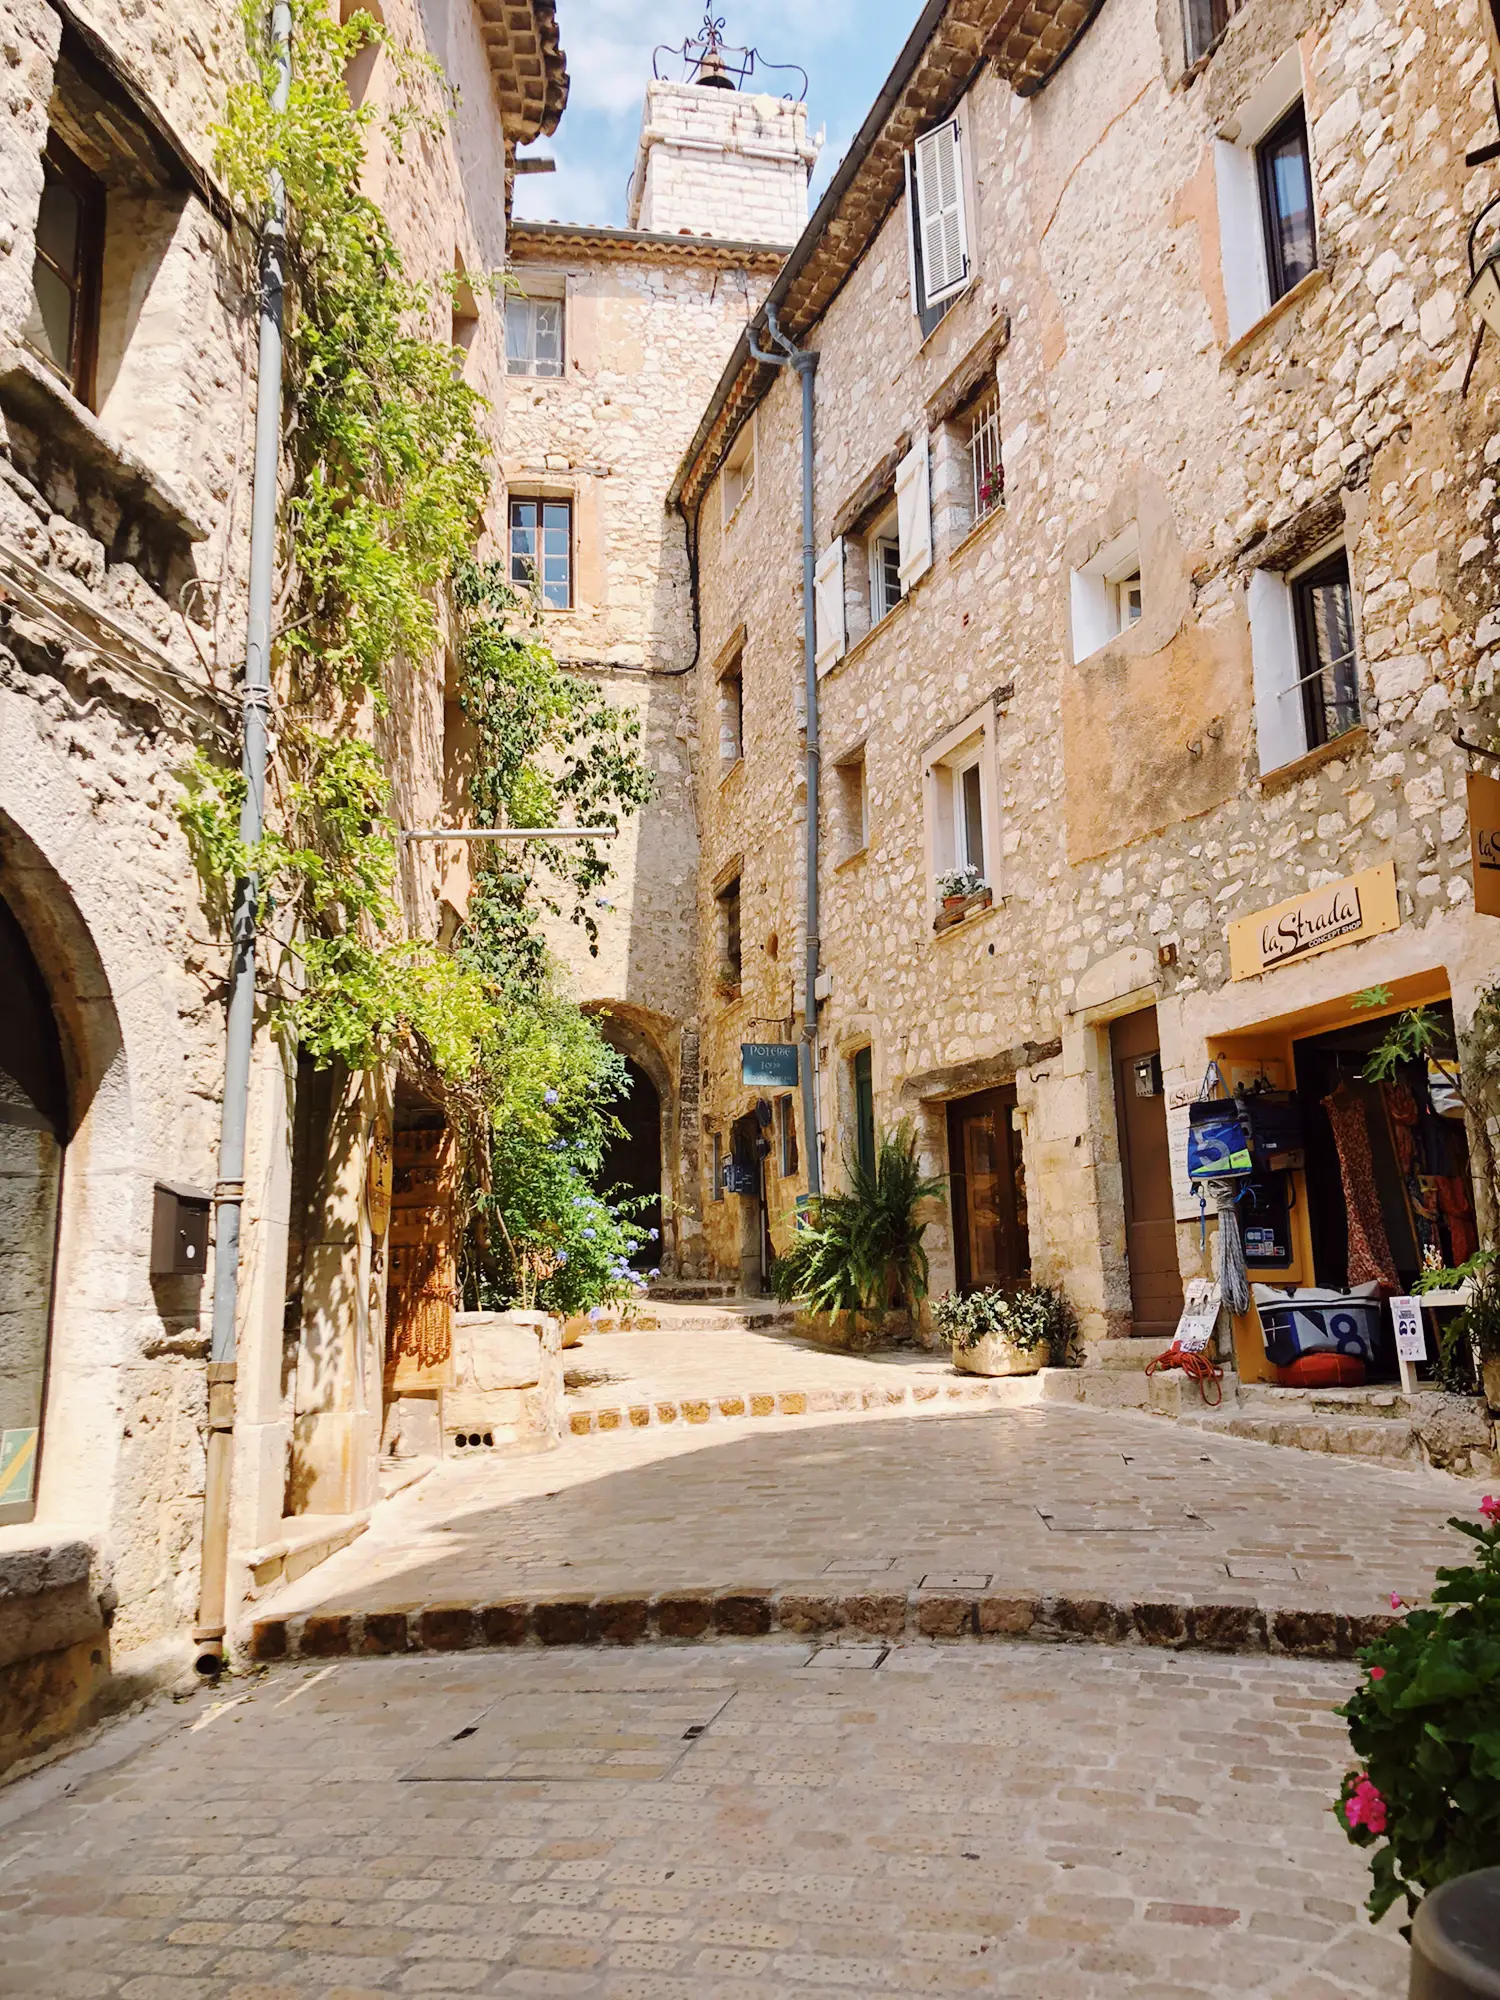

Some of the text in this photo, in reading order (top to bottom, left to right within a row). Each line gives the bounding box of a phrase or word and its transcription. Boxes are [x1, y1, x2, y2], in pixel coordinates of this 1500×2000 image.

[1308, 920, 1362, 948] CONCEPT SHOP
[1193, 1122, 1230, 1170] 5
